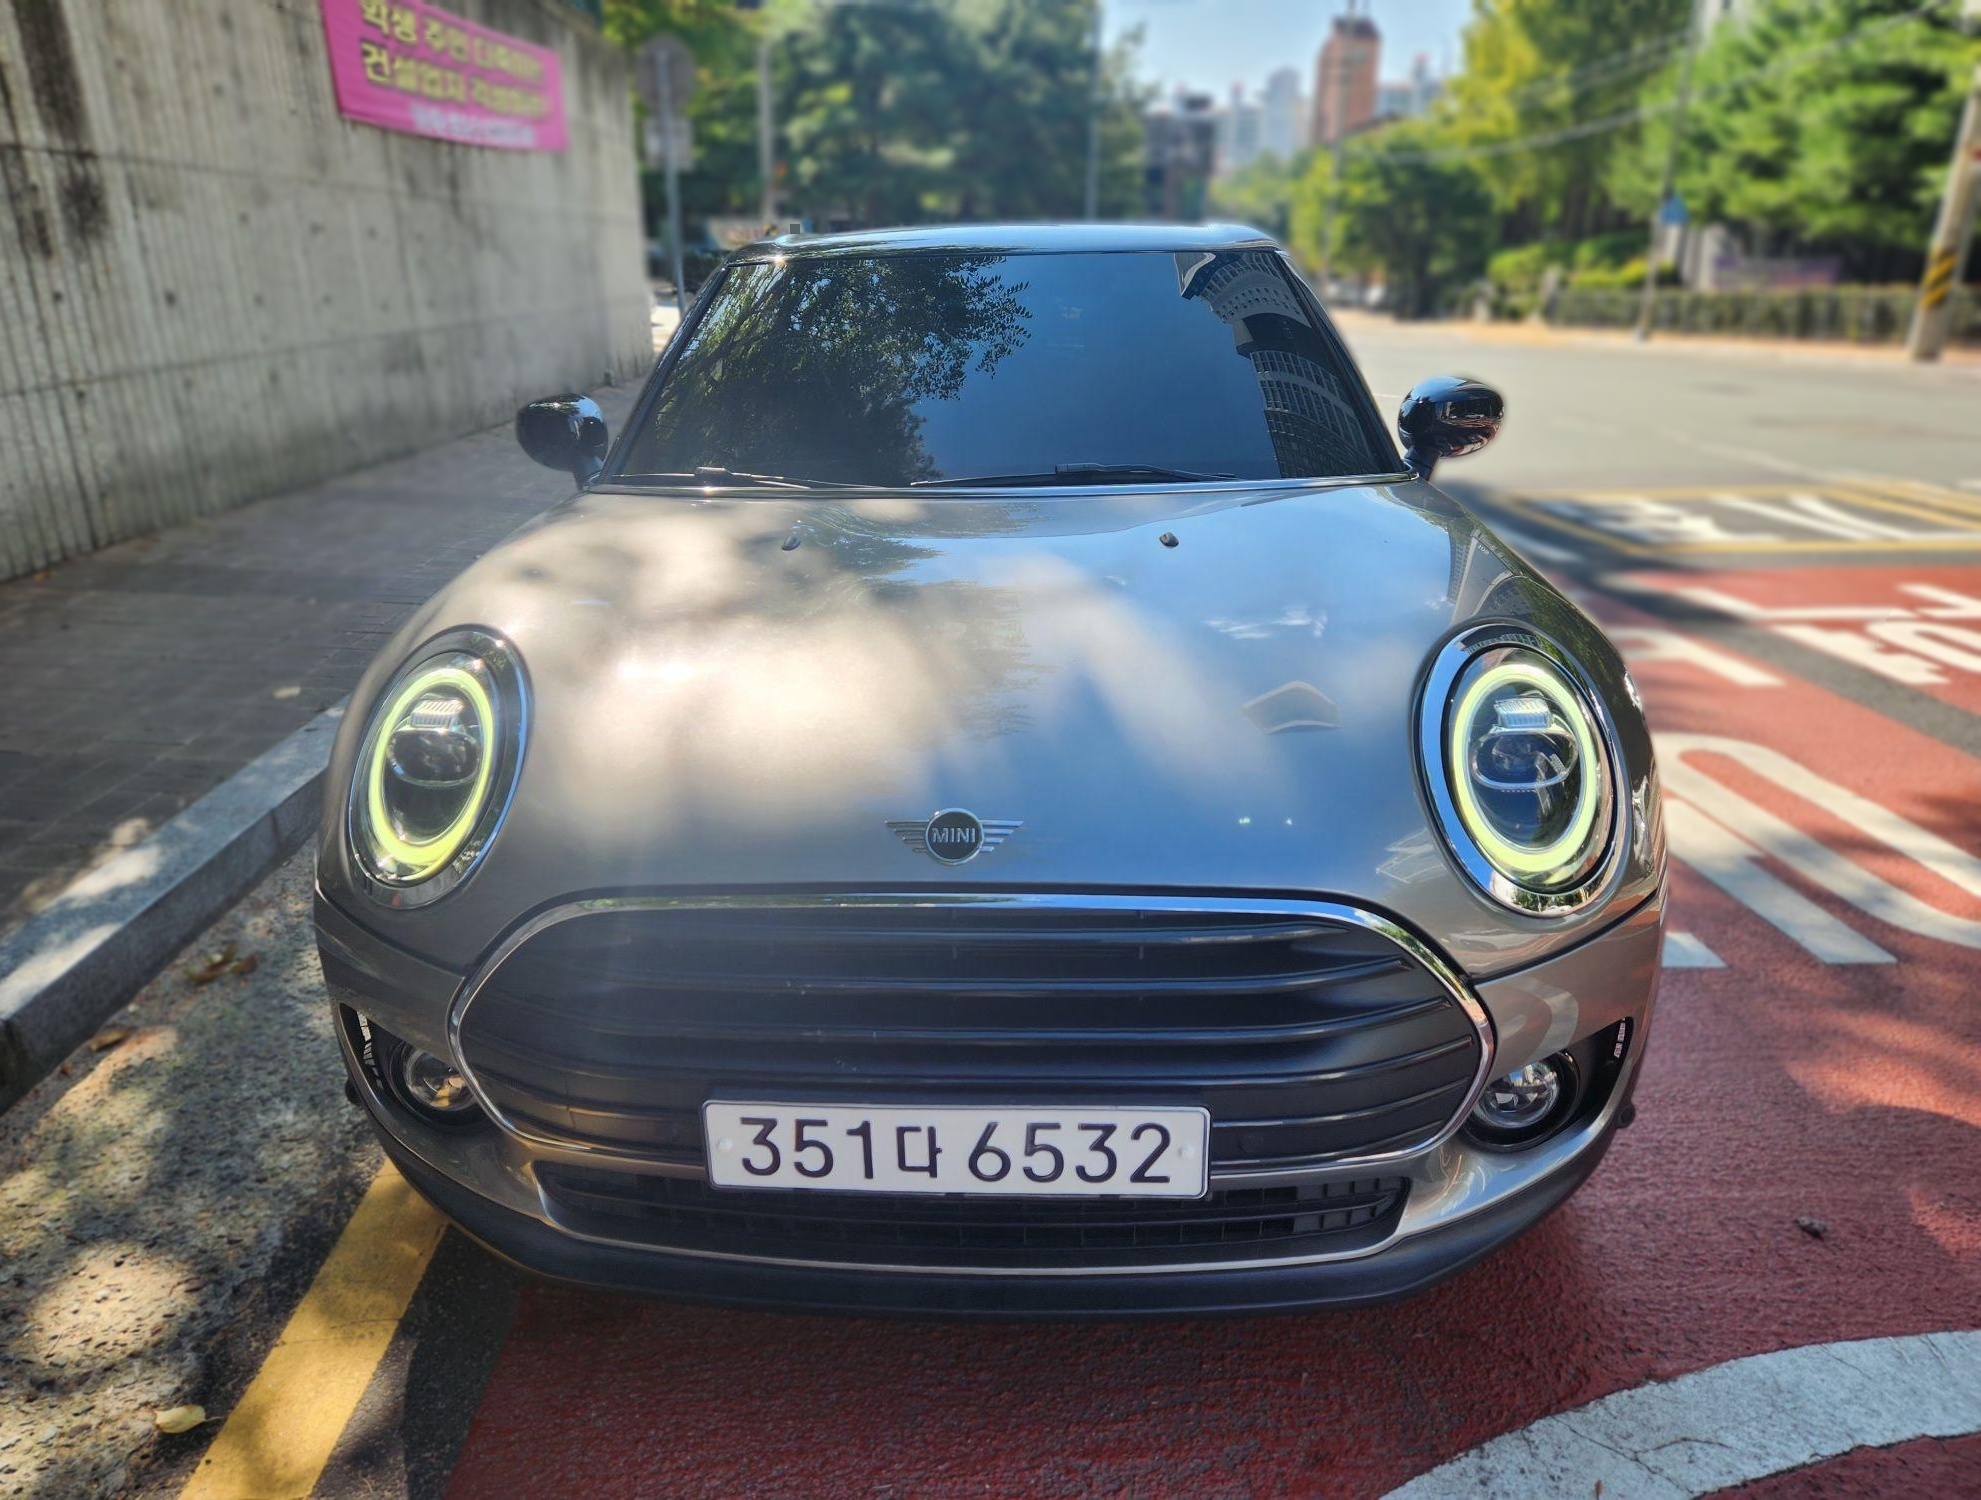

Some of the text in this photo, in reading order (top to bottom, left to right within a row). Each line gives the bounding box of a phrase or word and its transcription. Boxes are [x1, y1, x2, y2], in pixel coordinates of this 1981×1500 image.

[932, 828, 976, 843] MINI
[741, 1117, 1170, 1183] 351다 6532
